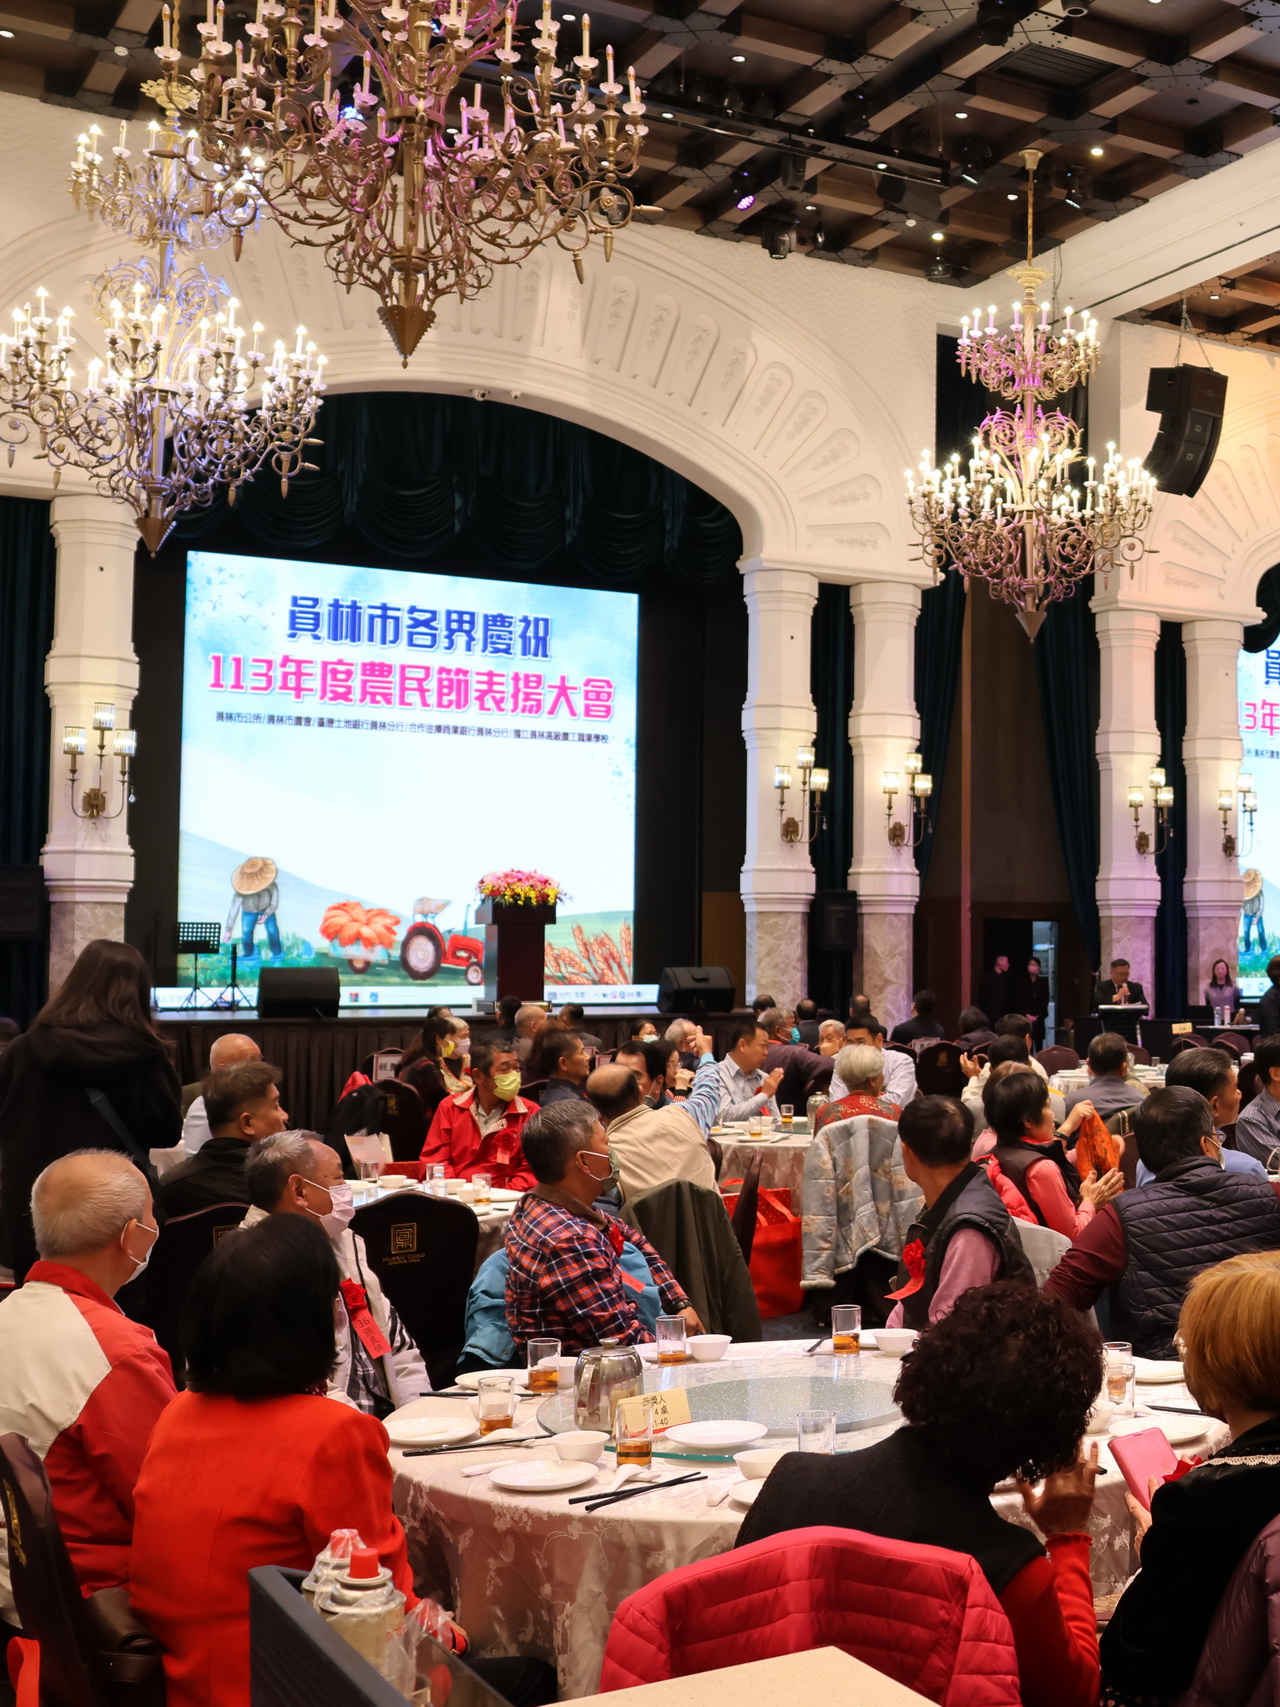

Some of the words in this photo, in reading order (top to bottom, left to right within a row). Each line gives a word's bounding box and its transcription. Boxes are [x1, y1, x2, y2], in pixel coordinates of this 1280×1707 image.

[287, 595, 550, 659] 員林市各界慶祝
[209, 654, 613, 719] 113年度農民節表揚大會
[356, 1316, 370, 1328] 36
[653, 1417, 668, 1427] 1-40
